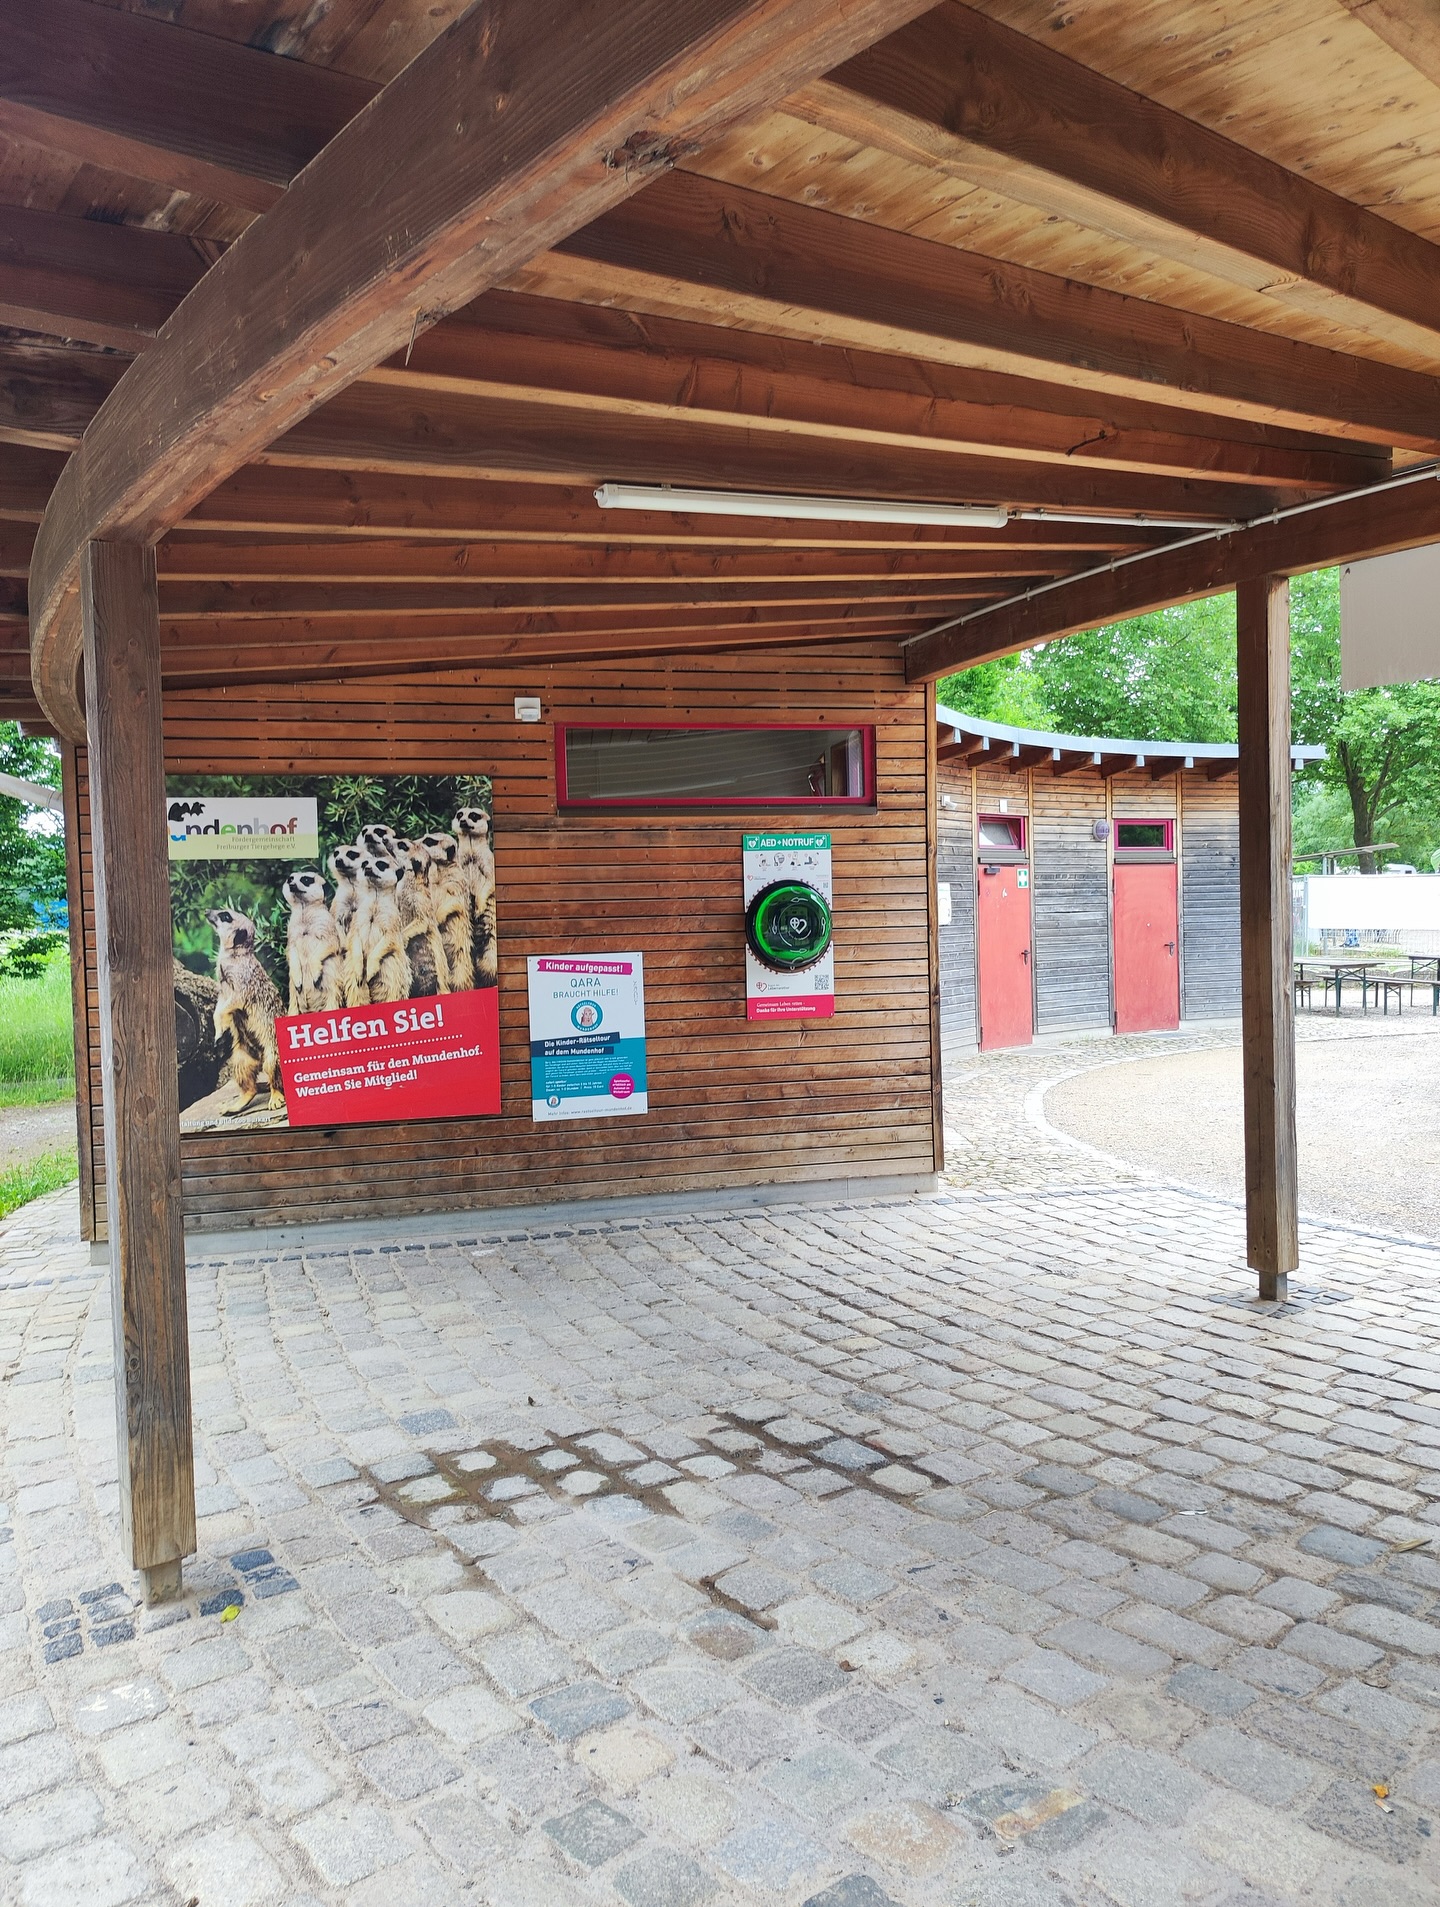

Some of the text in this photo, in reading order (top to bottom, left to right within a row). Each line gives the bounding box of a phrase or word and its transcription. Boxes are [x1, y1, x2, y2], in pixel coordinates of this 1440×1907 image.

[231, 835, 296, 844] Fördergemeinschaft
[760, 837, 814, 847] AED NOTRUF
[545, 961, 623, 974] Kinder aufgepasst!
[570, 977, 601, 988] QARA
[553, 988, 619, 999] BRAUCHT HILFE!
[287, 1003, 445, 1050] Helfen Sie!
[544, 1034, 611, 1048] Die Kinder-Rätseltour
[570, 1047, 605, 1055] Mundenhof
[293, 1044, 484, 1084] Gemeinsam für den Mundenhof.
[294, 1069, 418, 1098] Werden Sie Mitglied!
